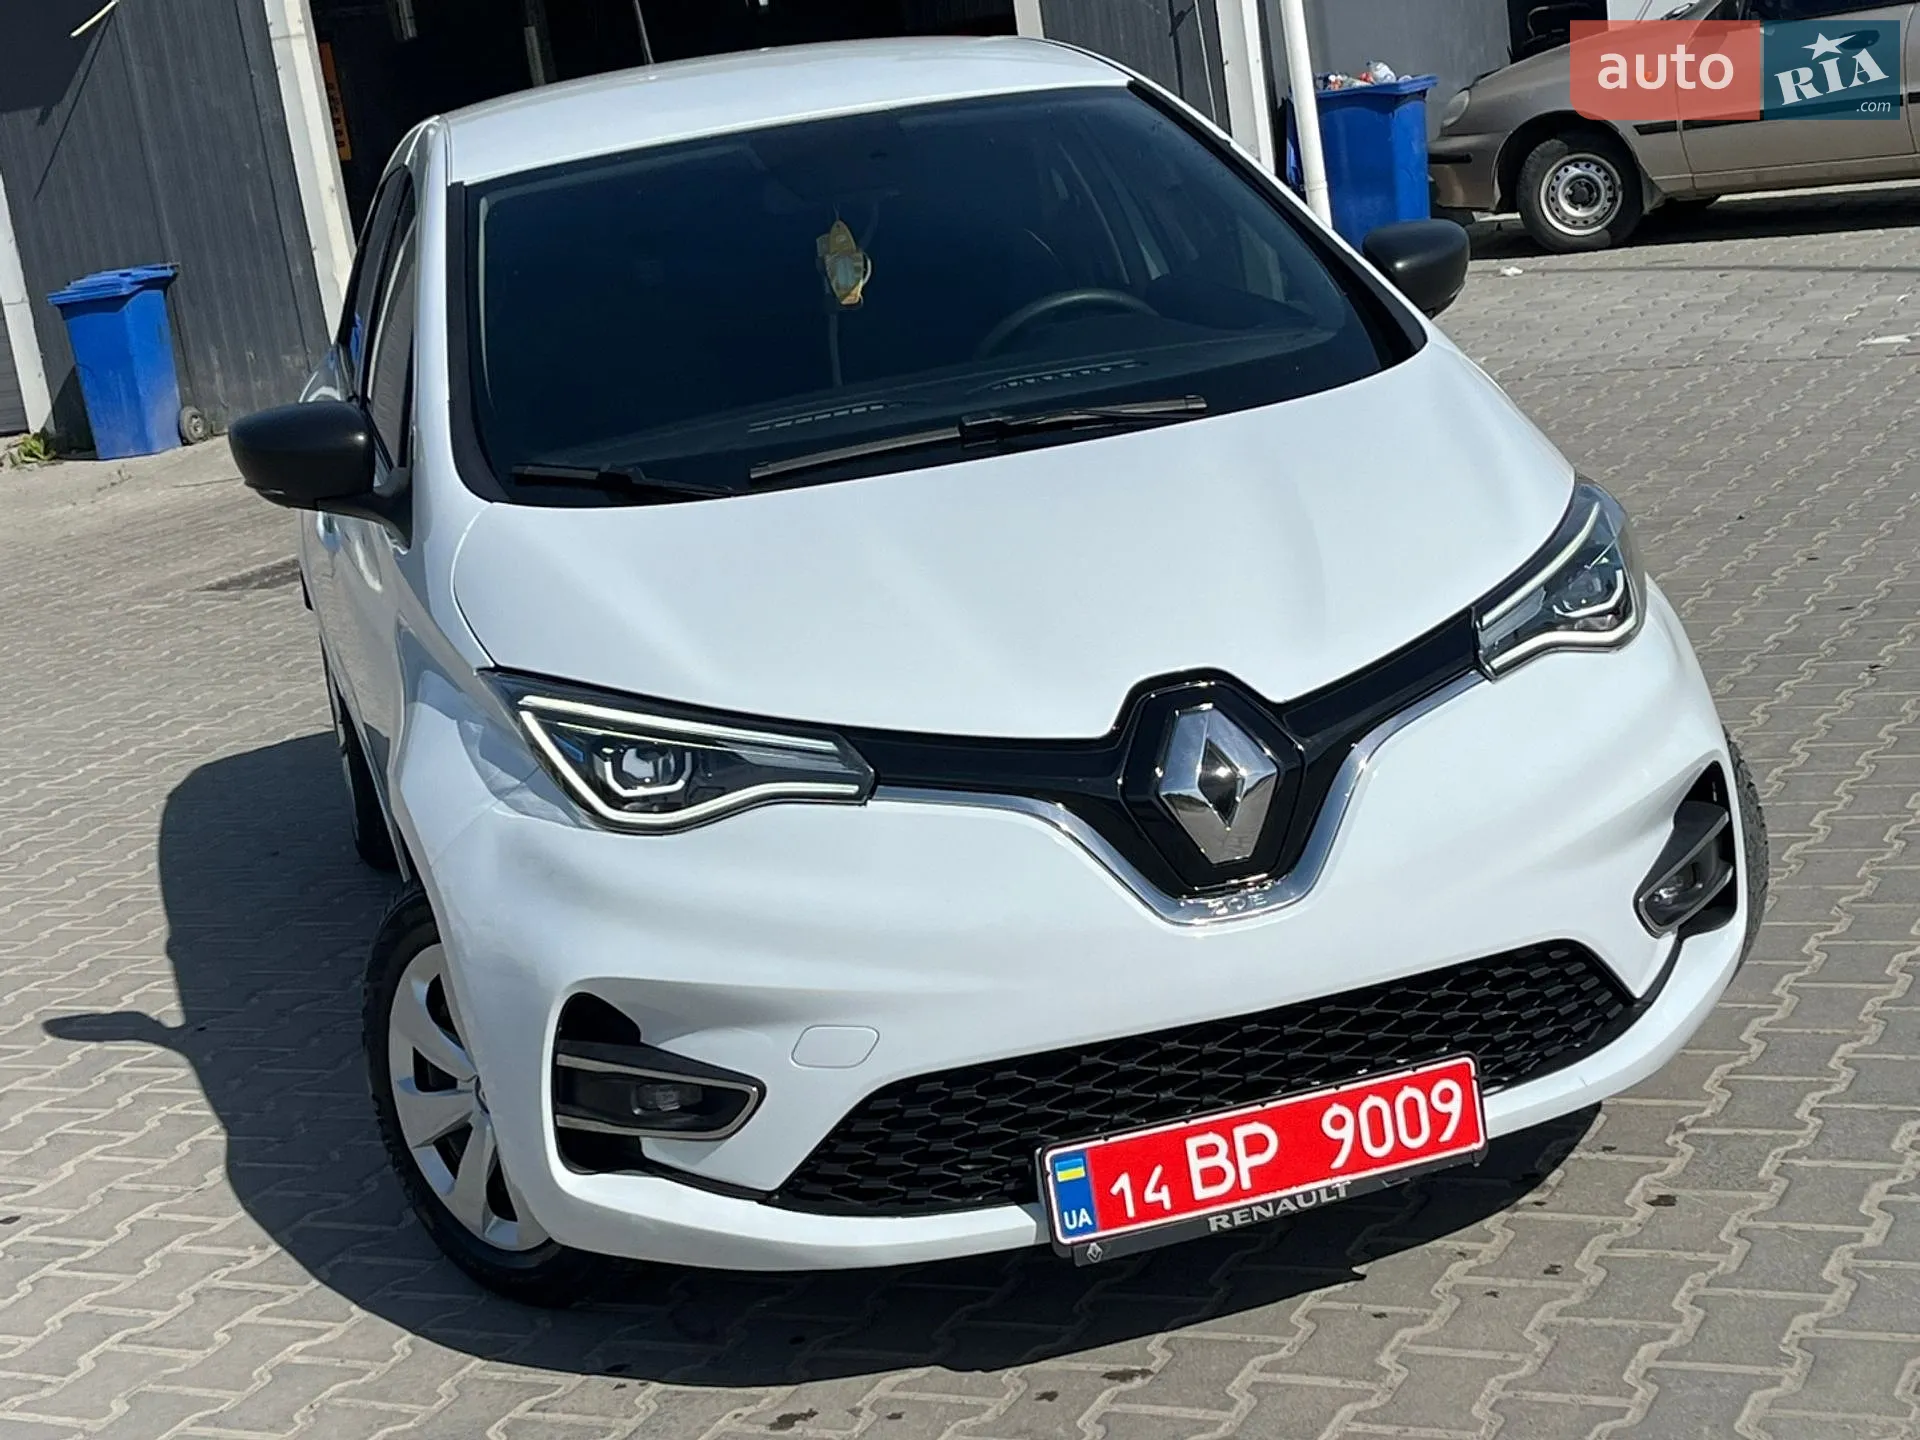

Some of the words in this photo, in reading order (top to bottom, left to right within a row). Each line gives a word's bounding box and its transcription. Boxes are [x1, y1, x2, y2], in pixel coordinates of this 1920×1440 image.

[1110, 1165, 1172, 1219] 14
[1185, 1121, 1279, 1202] BP
[1320, 1078, 1464, 1170] 9009
[1064, 1210, 1093, 1231] UA
[1208, 1180, 1352, 1233] RENAULT
